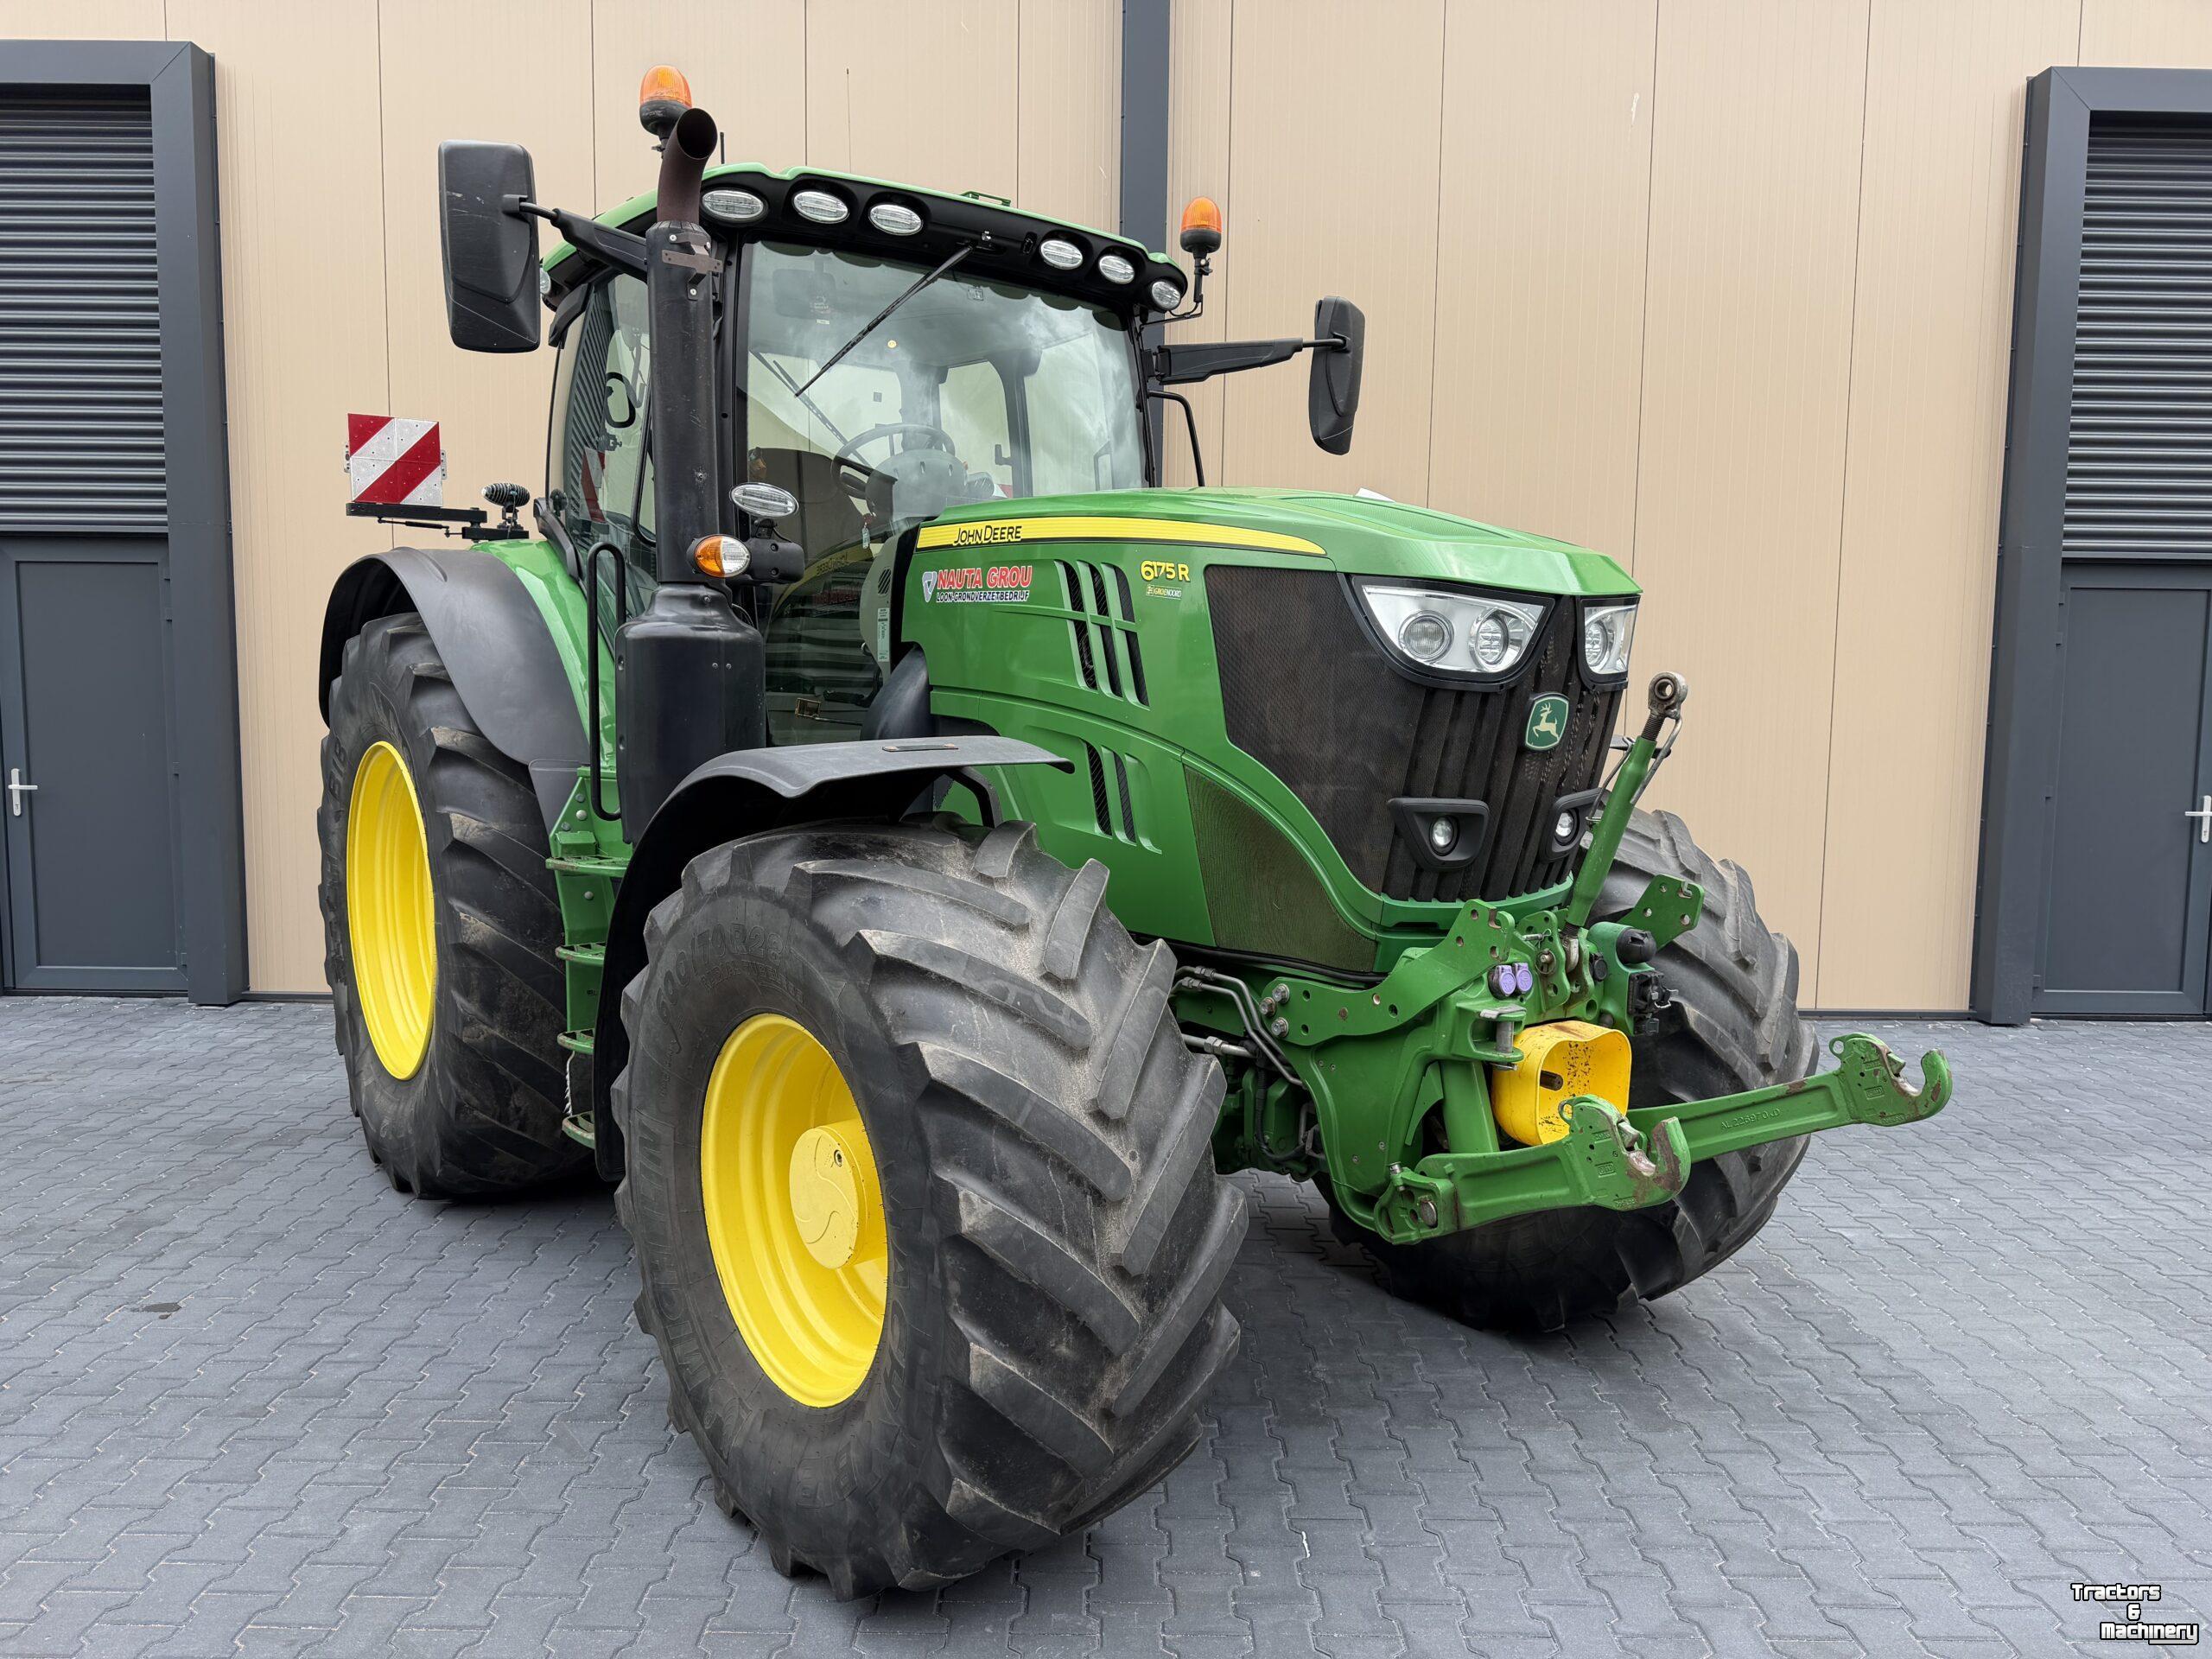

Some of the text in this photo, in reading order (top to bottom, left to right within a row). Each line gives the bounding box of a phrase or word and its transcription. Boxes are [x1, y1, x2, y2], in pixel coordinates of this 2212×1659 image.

[954, 524, 1022, 544] JOHN DEERE
[937, 566, 1033, 590] NAUTA GROU
